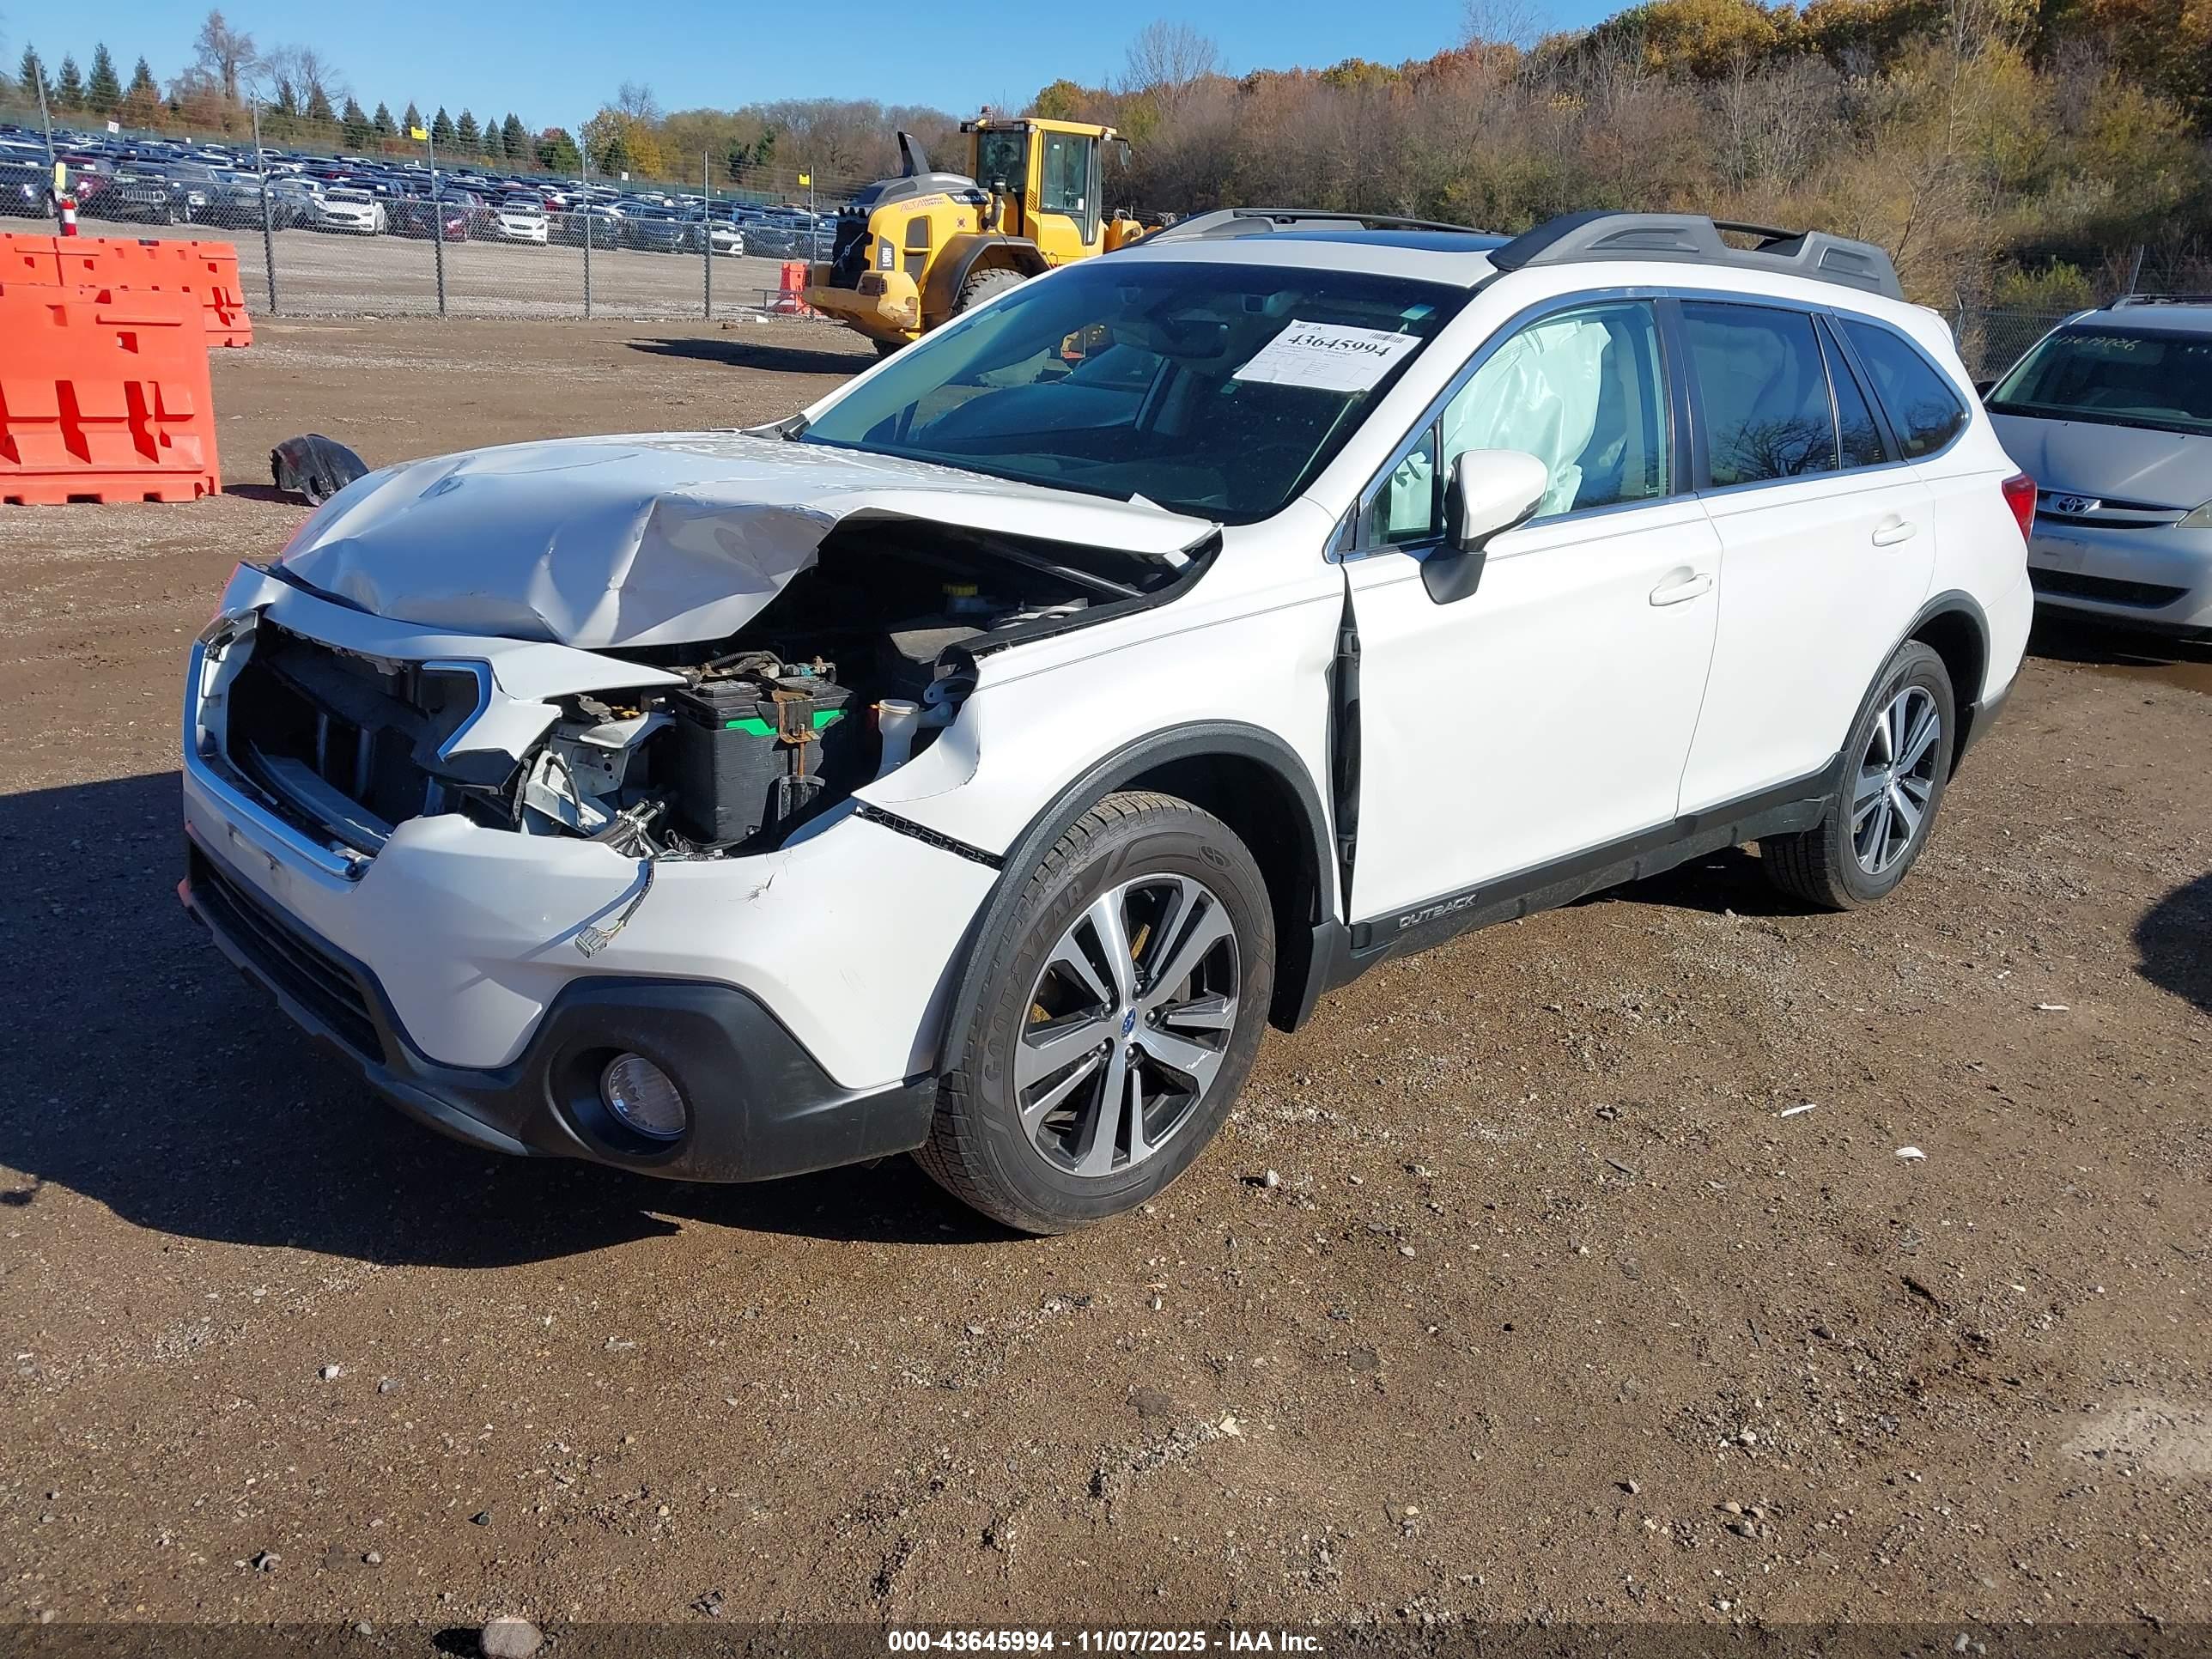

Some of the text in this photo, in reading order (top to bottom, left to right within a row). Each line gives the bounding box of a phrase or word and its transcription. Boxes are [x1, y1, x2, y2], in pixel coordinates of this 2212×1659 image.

[882, 246, 892, 267] L90H
[1287, 333, 1392, 357] 43645994
[1399, 894, 1477, 928] OUTBACK
